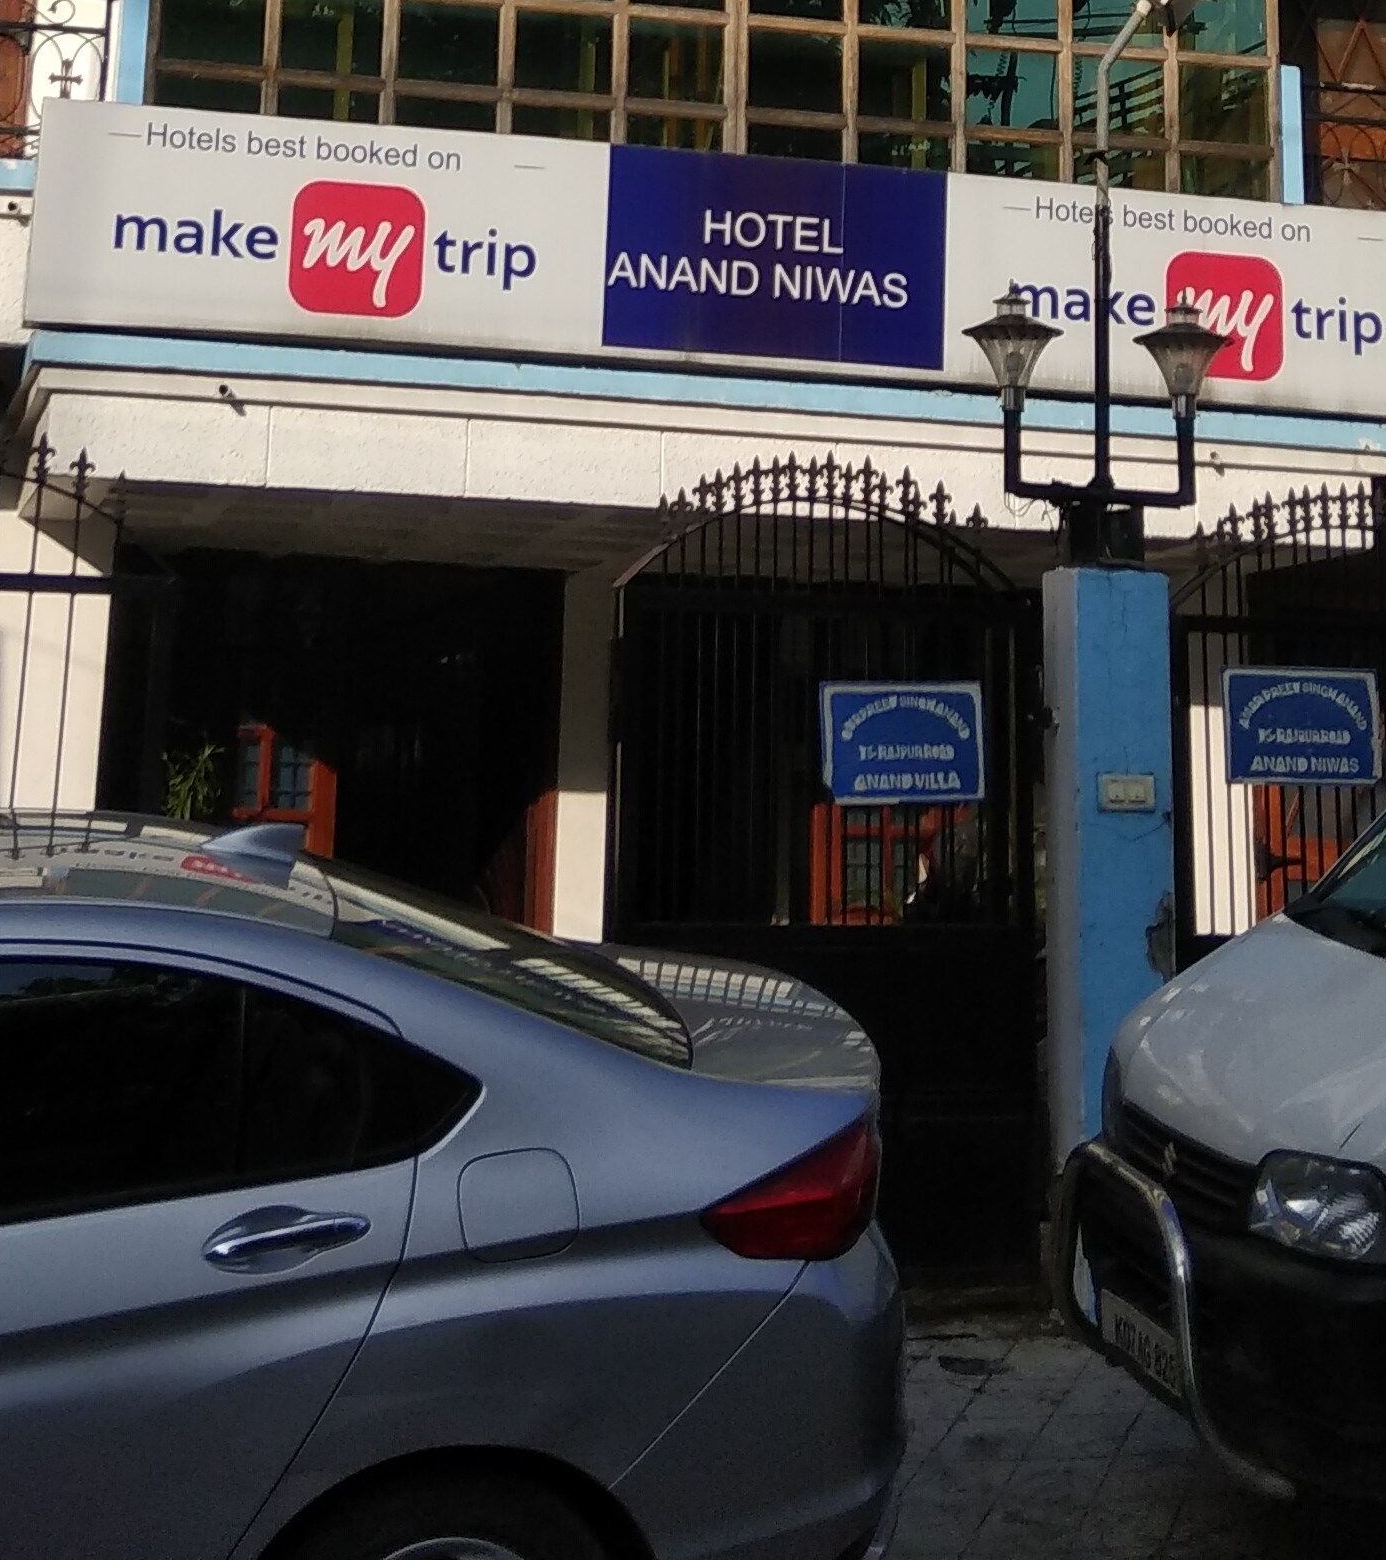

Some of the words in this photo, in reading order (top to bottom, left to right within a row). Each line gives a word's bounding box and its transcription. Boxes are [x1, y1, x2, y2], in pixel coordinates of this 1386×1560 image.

[146, 122, 237, 153] Hotels
[247, 131, 307, 159] best
[316, 136, 418, 168] booked
[427, 151, 461, 171] on
[704, 209, 844, 254] HOTEL
[1035, 196, 1113, 226] Hotes
[1123, 204, 1175, 232] best
[1183, 209, 1272, 240] booked
[1281, 223, 1311, 243] on
[113, 208, 279, 260] make
[302, 216, 418, 308] my
[433, 228, 537, 291] trip
[607, 253, 760, 297] ANAND
[773, 263, 909, 309] NIWAS
[1290, 296, 1384, 357] trip
[853, 772, 913, 791] ANAND
[914, 770, 962, 790] VILLA
[1250, 755, 1309, 773] ANAND
[1310, 756, 1360, 774] NIWAS
